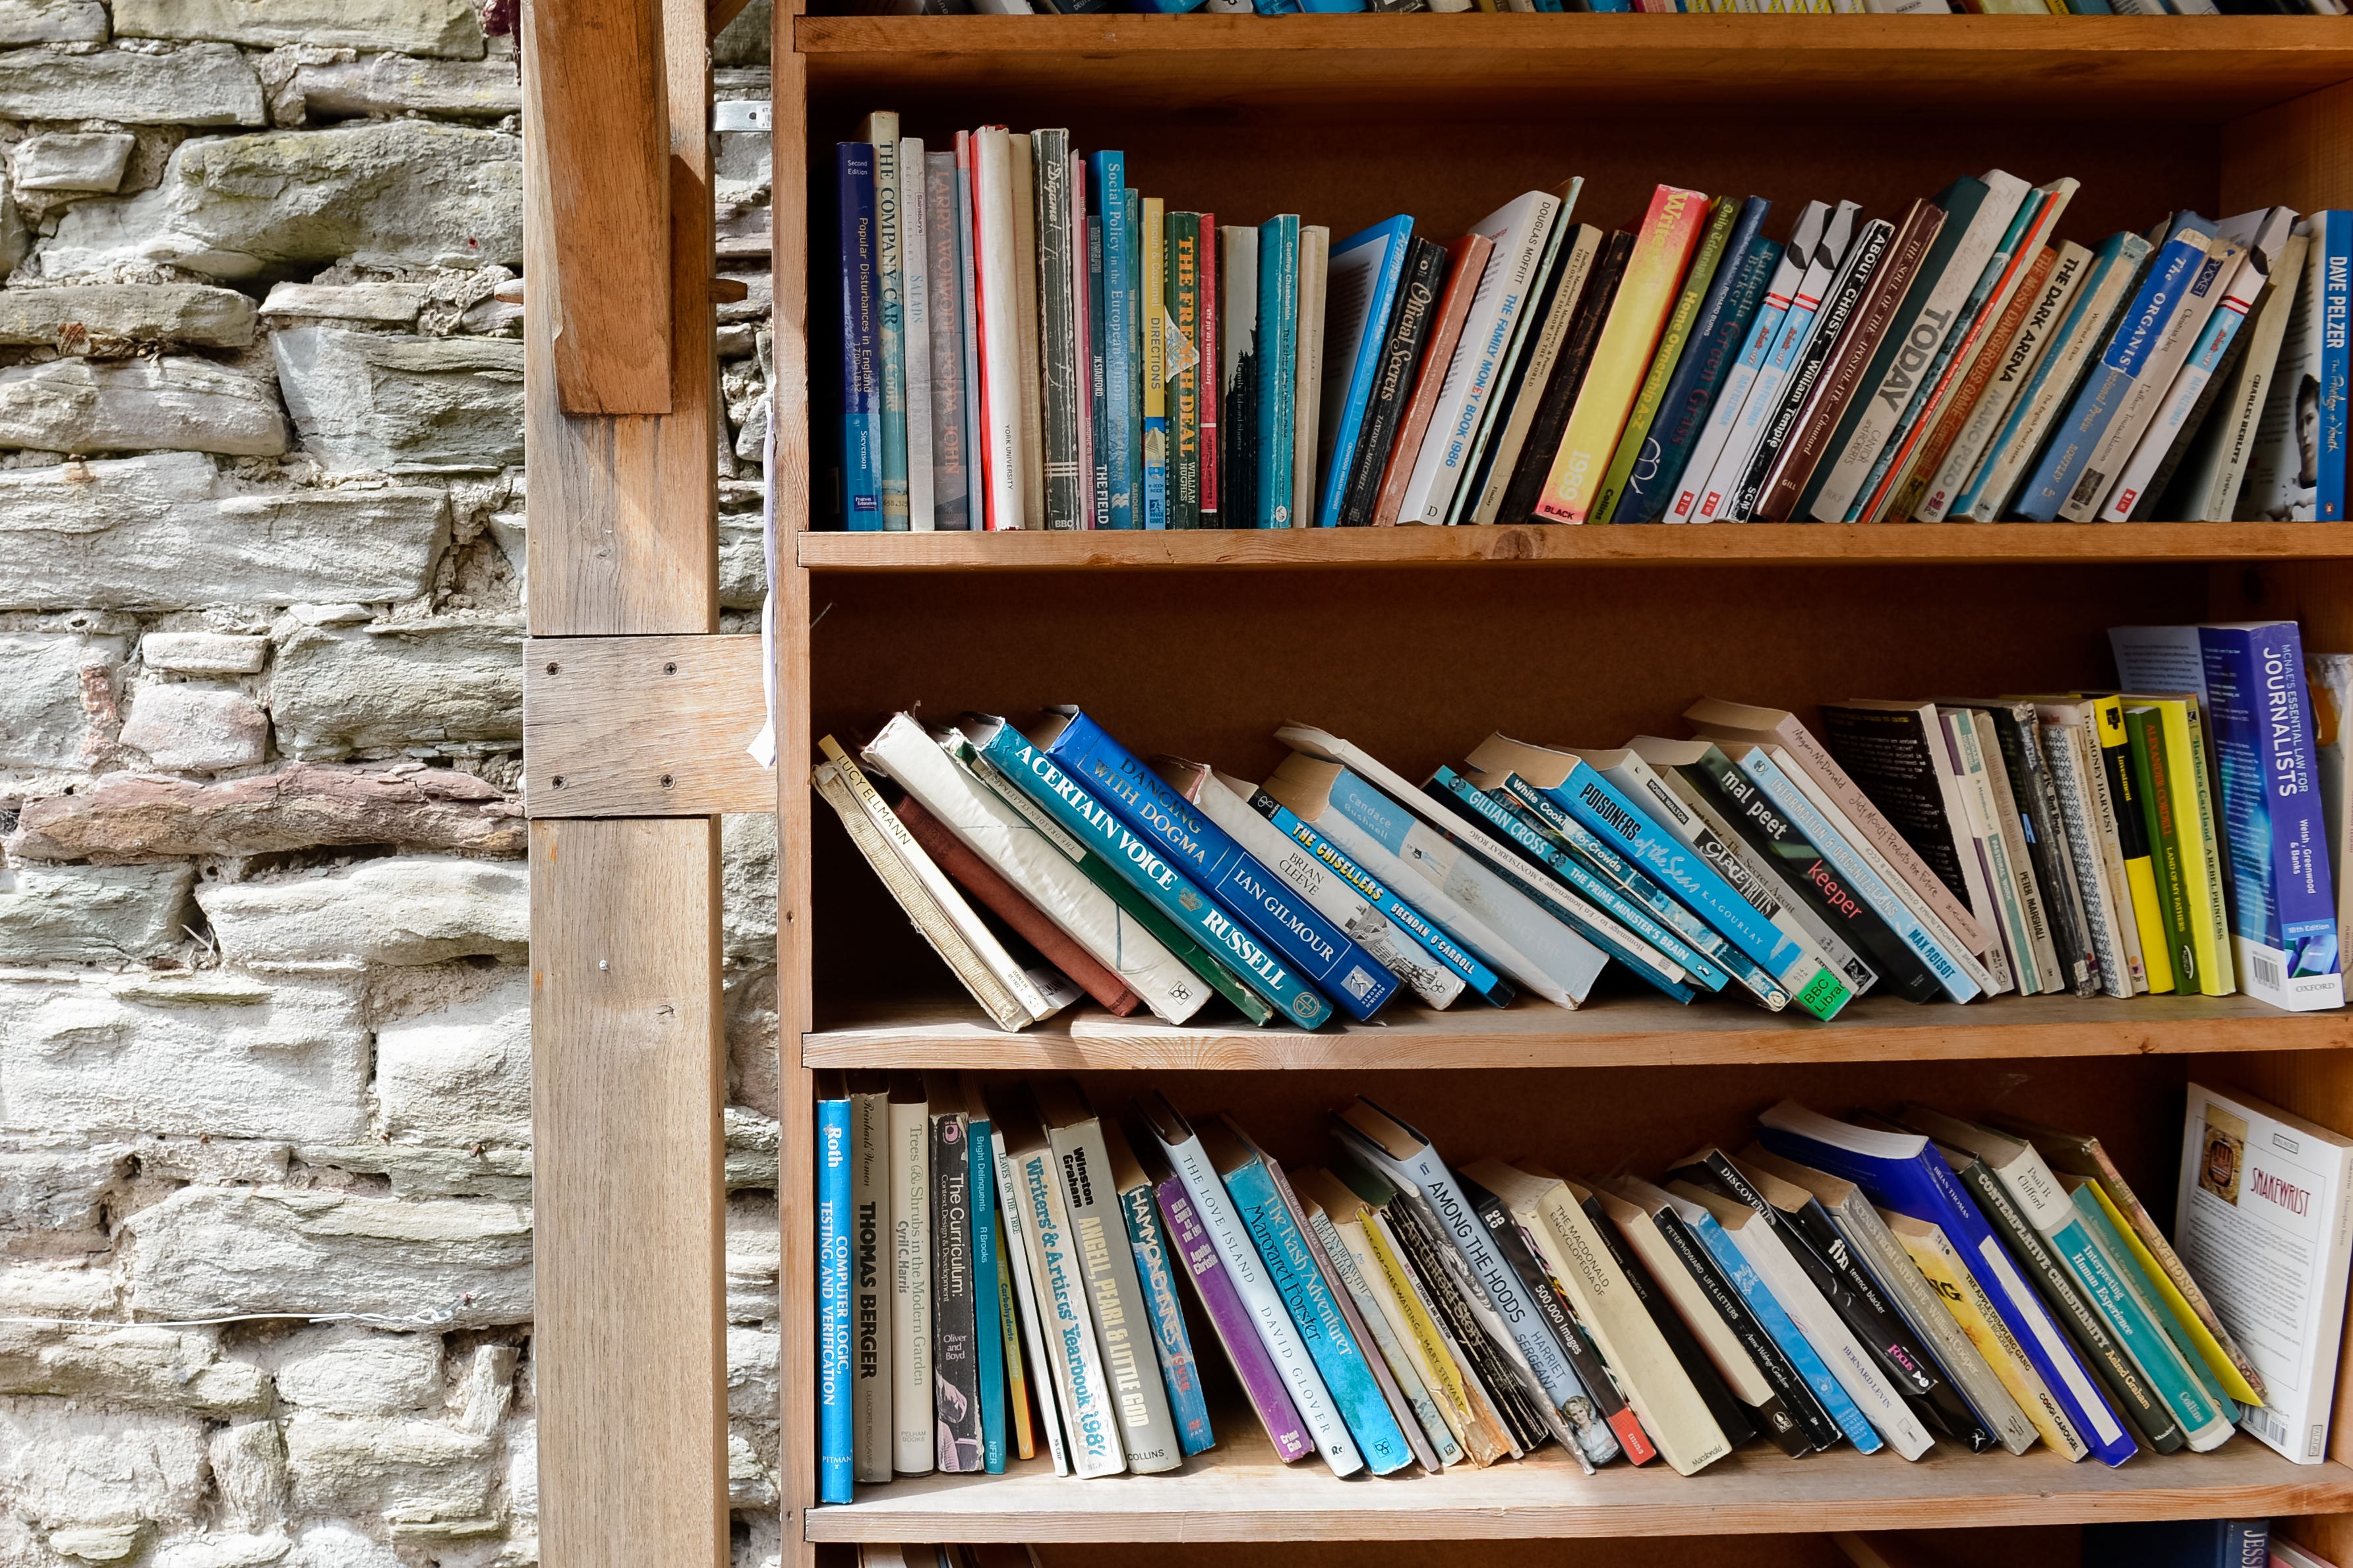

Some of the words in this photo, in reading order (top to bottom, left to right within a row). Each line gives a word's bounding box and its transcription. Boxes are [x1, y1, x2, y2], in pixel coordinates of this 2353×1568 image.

[879, 140, 893, 180] THE
[1108, 163, 1121, 205] Social
[859, 218, 868, 259] Popular
[881, 187, 897, 281] COMPANY
[1108, 211, 1122, 252] Policy
[1528, 201, 1552, 246] DOUGLAS
[1110, 254, 1119, 265] in
[1111, 269, 1120, 285] the
[1179, 236, 1193, 286] THE
[1513, 246, 1537, 285] MOFFITT
[2053, 257, 2080, 287] THE
[2164, 258, 2187, 283] The
[2328, 256, 2348, 292] DAVE
[859, 263, 870, 332] Disturbances
[883, 287, 898, 325] CAR
[1110, 291, 1124, 354] European
[1402, 281, 1432, 345] Official
[1501, 293, 1518, 316] THE
[2037, 286, 2064, 332] DARK
[2326, 295, 2348, 349] PELZER
[862, 335, 869, 344] in
[1150, 317, 1161, 390] DIRECTIONS
[1178, 291, 1194, 394] FRENCH
[1487, 316, 1510, 359] FAMILY
[1998, 330, 2037, 383] ARENA
[2114, 291, 2167, 375] ORGANIST
[862, 349, 872, 393] England
[1112, 361, 1125, 401] Union
[1381, 337, 1412, 401] Secrets
[1468, 355, 1495, 403] MONEY
[1881, 307, 1954, 413] TODAY
[1179, 393, 1195, 457] DEAL
[1456, 402, 1478, 441] BOOK
[2019, 426, 2035, 445] Penal
[2027, 403, 2047, 428] English
[1096, 464, 1107, 485] THE
[1445, 439, 1465, 469] 1986
[1559, 450, 1592, 500] 1989
[2005, 442, 2025, 467] System
[1097, 486, 1109, 525] FIELD
[1544, 505, 1575, 520] BLACK
[1595, 488, 1614, 521] Collins
[2281, 643, 2296, 690] MCNAE'S
[2262, 646, 2298, 798] JOURNALISTS
[2286, 690, 2303, 747] ESSENTIAL
[2117, 754, 2133, 802] Investment
[2292, 747, 2306, 770] LAW
[2296, 770, 2309, 792] FOR
[836, 753, 866, 790] LUCY
[861, 786, 911, 846] ELLMANN
[1015, 745, 1029, 764] A
[1028, 753, 1121, 840] CERTAIN
[1117, 832, 1179, 892] VOICE
[1093, 758, 1141, 807] WITH
[1139, 801, 1208, 865] DOGMA
[1120, 757, 1205, 834] DANCING
[1348, 792, 1392, 829] Candace
[1579, 781, 1642, 842] POISONERS
[1648, 780, 1669, 803] ROBIN
[1664, 797, 1688, 825] WALTON
[1721, 769, 1754, 803] mal
[1746, 800, 1789, 841] peet
[1344, 803, 1389, 840] Bushnell
[1468, 791, 1512, 828] GILLIAN
[1510, 818, 1547, 856] CROSS
[1292, 822, 1317, 847] THE
[1316, 842, 1385, 900] CHISELLERS
[1569, 866, 1587, 883] THE
[1585, 875, 1615, 906] PRIME
[1612, 895, 1661, 940] MINISTER'S
[1655, 933, 1691, 962] BRAIN
[1806, 860, 1862, 919] keeper
[2019, 871, 2034, 902] PETER
[2027, 898, 2047, 943] MARSHALL
[1232, 868, 1266, 902] IAN
[1264, 896, 1336, 964] GILMOUR
[1390, 902, 1430, 939] BRENDAN
[1429, 933, 1475, 975] O'CARROLL
[1201, 908, 1288, 991] RUSSELL
[1909, 928, 1933, 954] MAX
[1926, 947, 1957, 980] BOISOT
[1804, 977, 1830, 1004] BBC
[2295, 981, 2337, 994] OXFORD
[827, 1124, 843, 1168] Roth
[910, 1124, 923, 1161] Trees
[976, 1135, 985, 1161] Bright
[998, 1152, 1009, 1179] LEAVES
[949, 1173, 965, 1205] The
[977, 1163, 986, 1213] Delinquents
[1003, 1181, 1013, 1193] ON
[1025, 1155, 1055, 1231] Writers'
[1061, 1153, 1083, 1209] Graham
[1072, 1146, 1095, 1207] Winston
[1719, 1166, 1778, 1226] DISCOVERIES
[2249, 1167, 2311, 1219] SNAKEWRIST
[911, 1186, 924, 1237] Shrubs
[1007, 1196, 1017, 1213] THE
[1010, 1215, 1021, 1235] TREE
[1183, 1153, 1205, 1184] THE
[1199, 1187, 1223, 1228] LOVE
[1222, 1230, 1255, 1285] ISLAND
[821, 1200, 834, 1263] TESTING,
[859, 1201, 876, 1288] THOMAS
[912, 1239, 920, 1254] in
[949, 1206, 966, 1298] Curriculum:
[1042, 1232, 1059, 1249] &
[1427, 1180, 1473, 1239] AMONG
[1463, 1234, 1494, 1270] THE
[1487, 1264, 1527, 1325] HOODS
[821, 1265, 834, 1300] AND
[836, 1235, 849, 1319] COMPUTER
[912, 1257, 924, 1278] the
[1044, 1250, 1073, 1321] Artists'
[1244, 1205, 1290, 1283] Margaret
[1284, 1279, 1322, 1341] Forster
[1263, 1194, 1284, 1233] The
[1278, 1227, 1310, 1271] Rash
[1303, 1265, 1354, 1356] Adventurer
[1977, 1172, 2050, 1271] CONTEMPLATIVE
[2046, 1267, 2110, 1350] CHRISTIANITY
[2081, 1244, 2126, 1302] Interpreting
[912, 1281, 926, 1330] Modern
[2071, 1251, 2100, 1291] Human
[2095, 1286, 2134, 1337] Experience
[860, 1294, 878, 1380] BERGER
[1534, 1283, 1566, 1325] 500,000
[1558, 1322, 1583, 1356] Images
[821, 1304, 835, 1406] VERIFICATION
[837, 1324, 849, 1375] LOGIC,
[913, 1335, 926, 1387] Garden
[1063, 1325, 1090, 1409] Yearbook
[1260, 1306, 1294, 1360] DAVID
[1292, 1367, 1332, 1435] GLOVER
[2178, 1390, 2205, 1424] Collins
[1080, 1410, 1106, 1457] 1987
[1127, 1449, 1165, 1462] COLLINS
[1691, 1443, 1724, 1468] Macdonald
[822, 1455, 852, 1464] PITMAN
